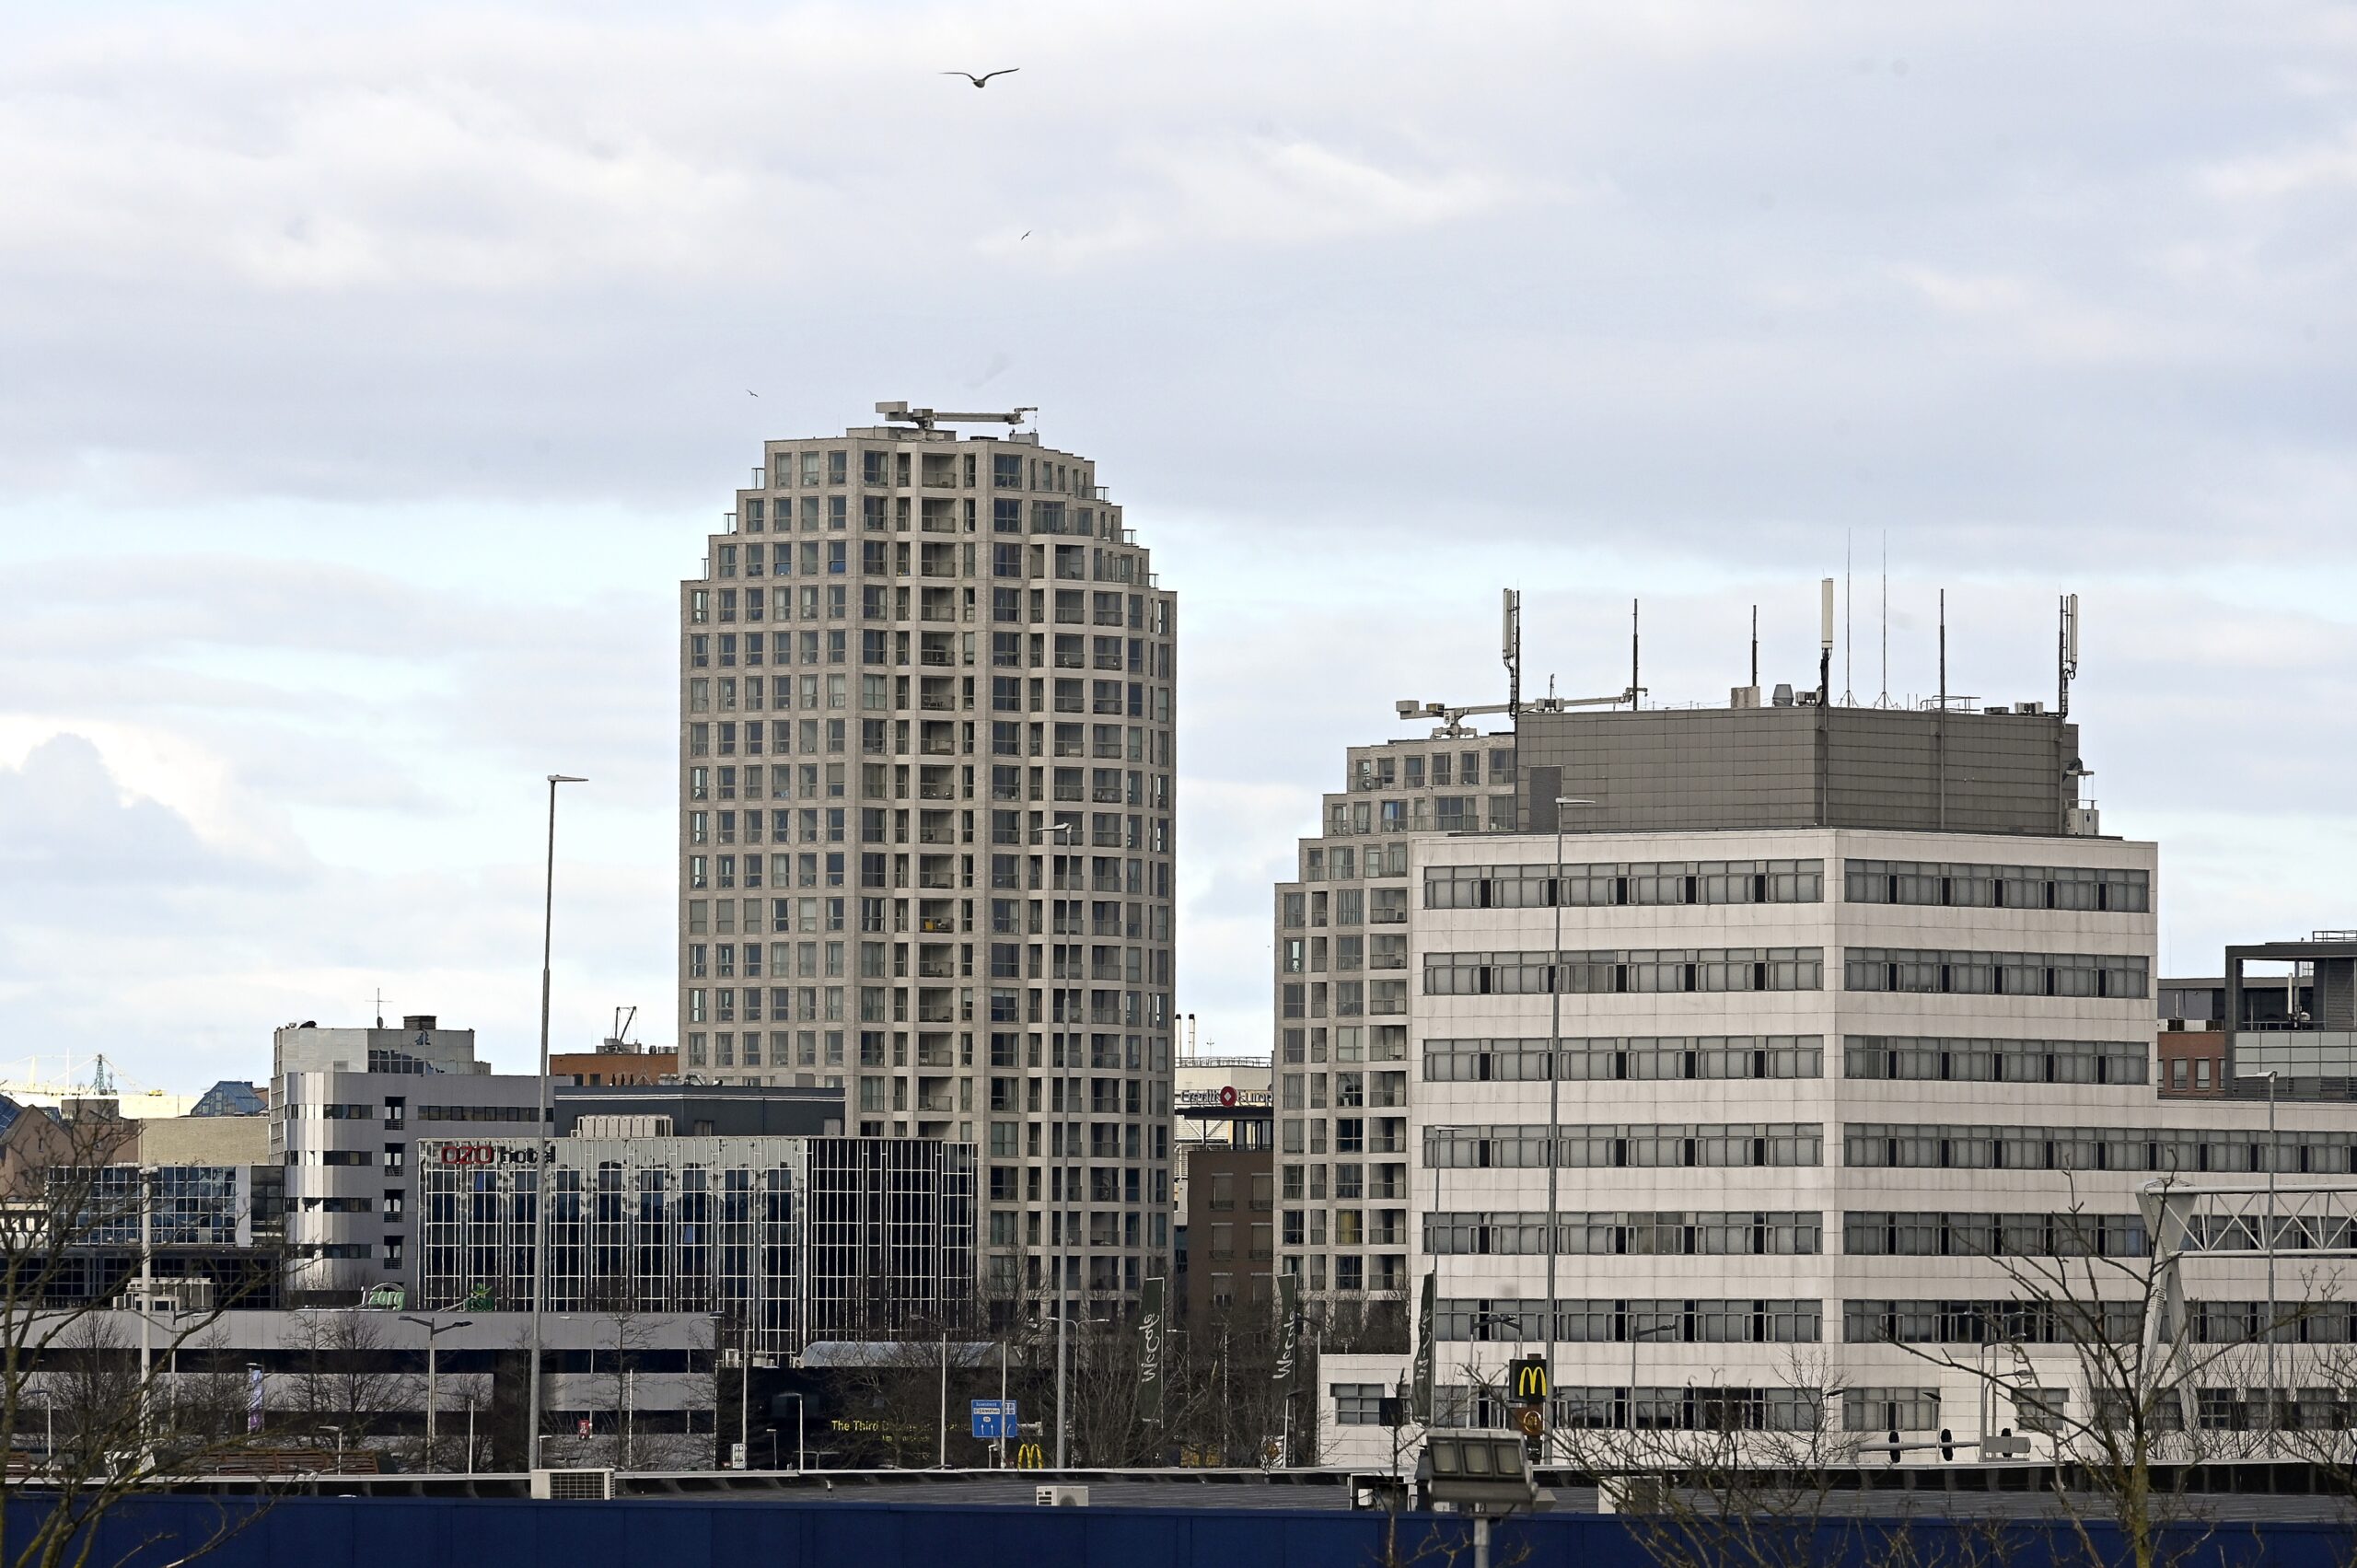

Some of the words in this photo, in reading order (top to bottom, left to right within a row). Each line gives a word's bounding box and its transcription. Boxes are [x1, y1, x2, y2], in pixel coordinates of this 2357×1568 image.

[442, 1145, 495, 1165] OZO
[831, 1420, 850, 1432] The
[853, 1420, 879, 1432] Third
